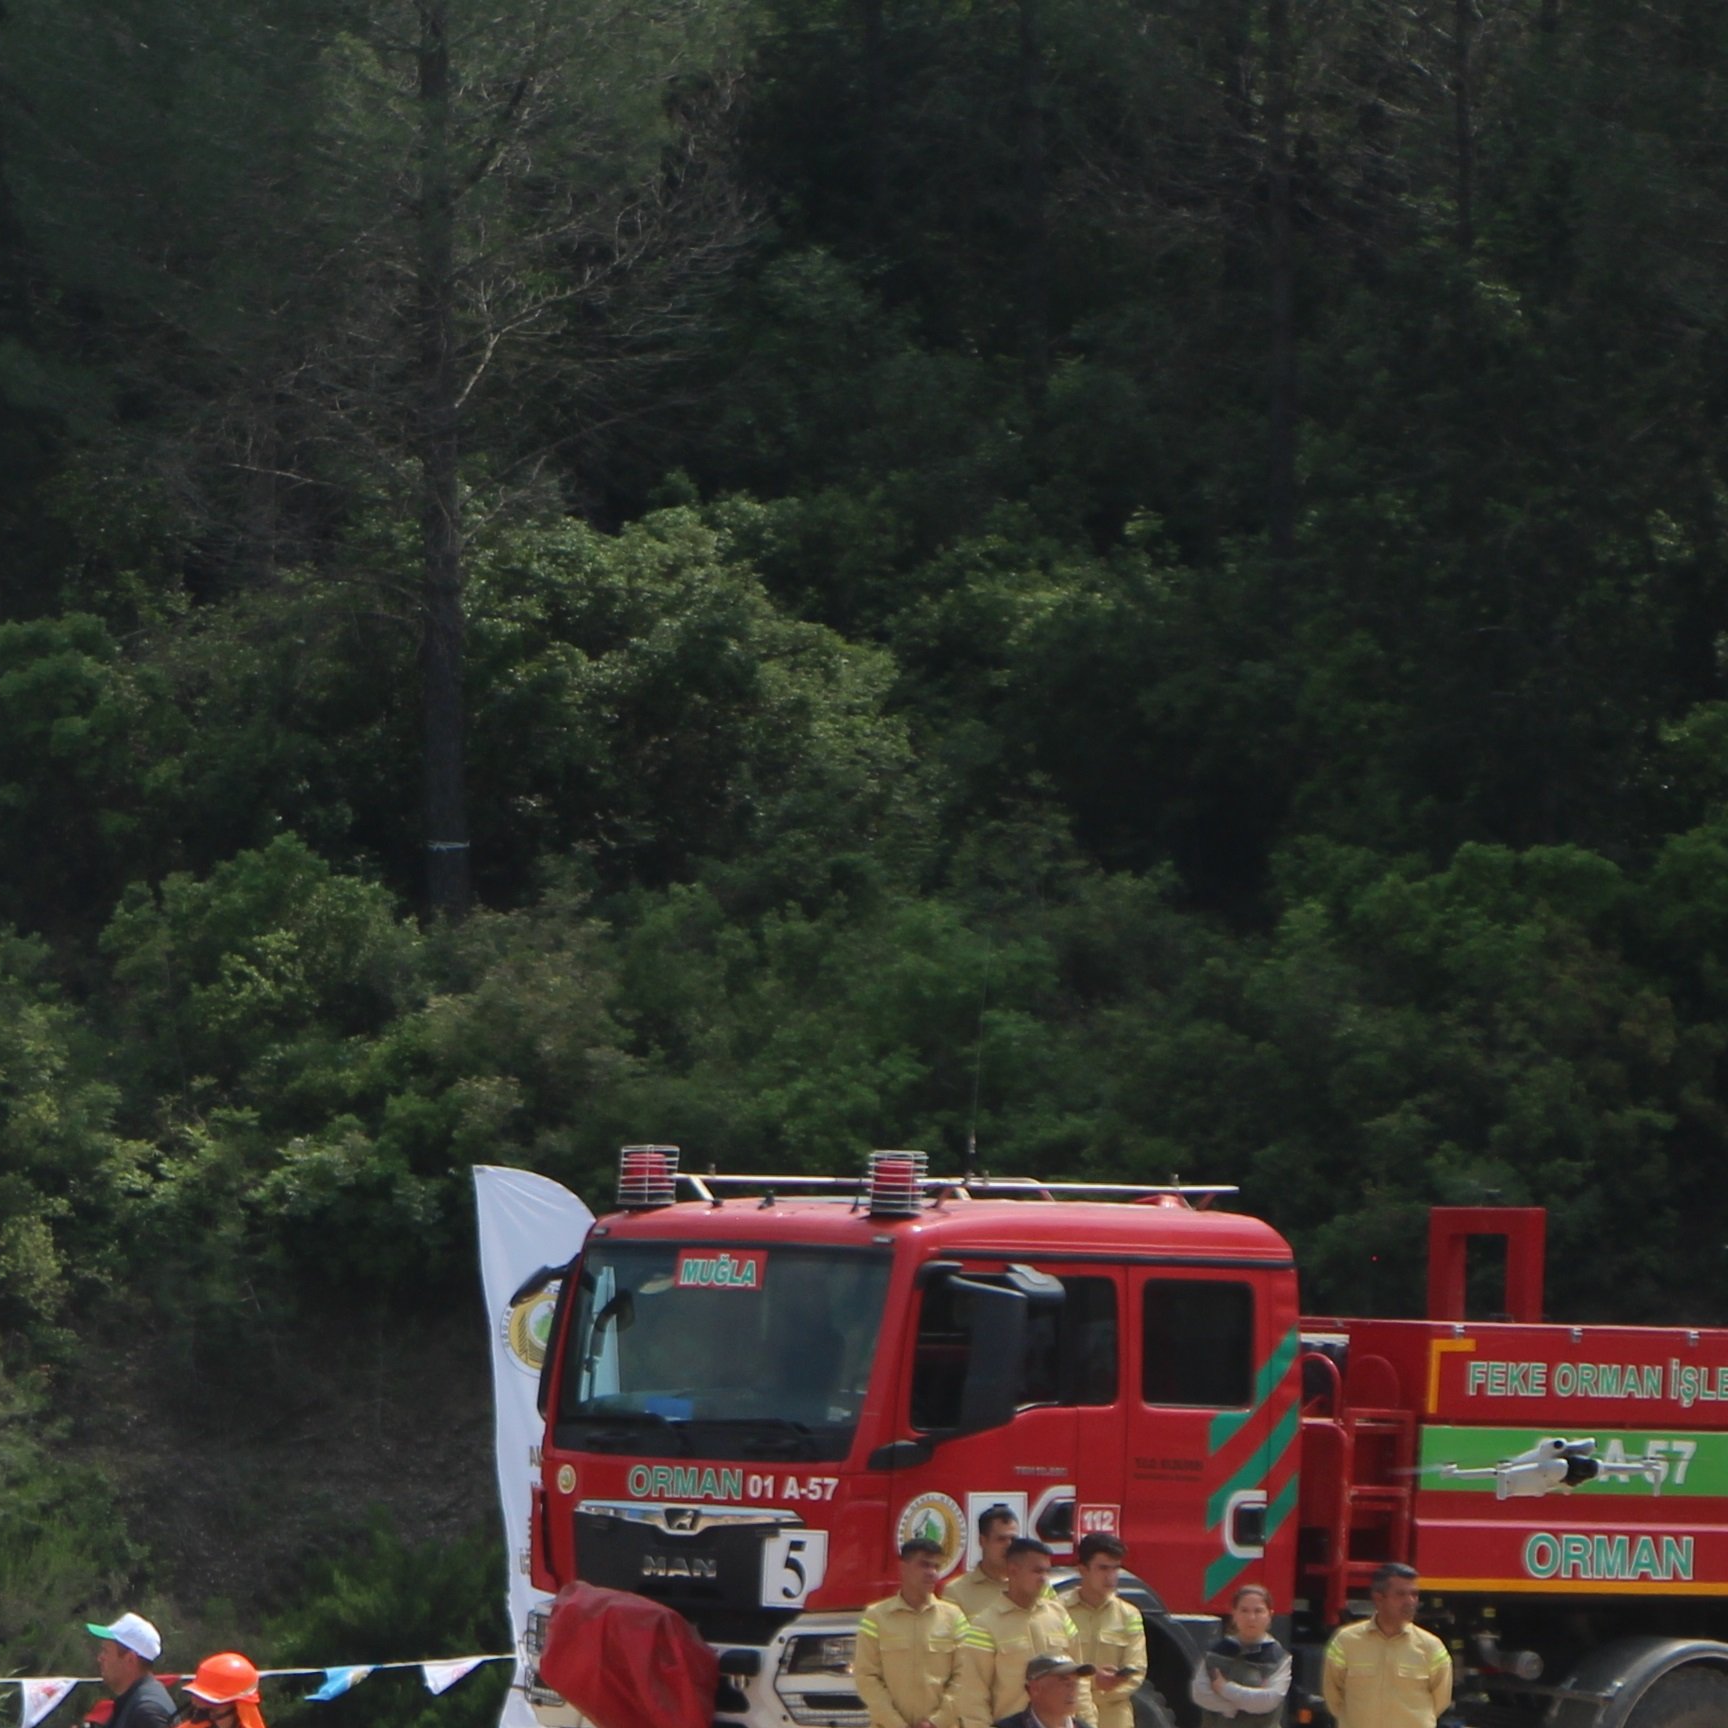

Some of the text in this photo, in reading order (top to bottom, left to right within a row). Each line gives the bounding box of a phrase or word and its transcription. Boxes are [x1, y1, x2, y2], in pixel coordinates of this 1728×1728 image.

[679, 1253, 757, 1287] MUĞLA
[1466, 1361, 1547, 1397] FEKE
[1553, 1363, 1663, 1399] ORMAN
[628, 1464, 840, 1501] ORMAN 01 A-57
[1084, 1510, 1115, 1531] 112
[642, 1554, 718, 1579] MAN
[782, 1540, 808, 1599] 5
[1525, 1532, 1694, 1581] ORMAN
